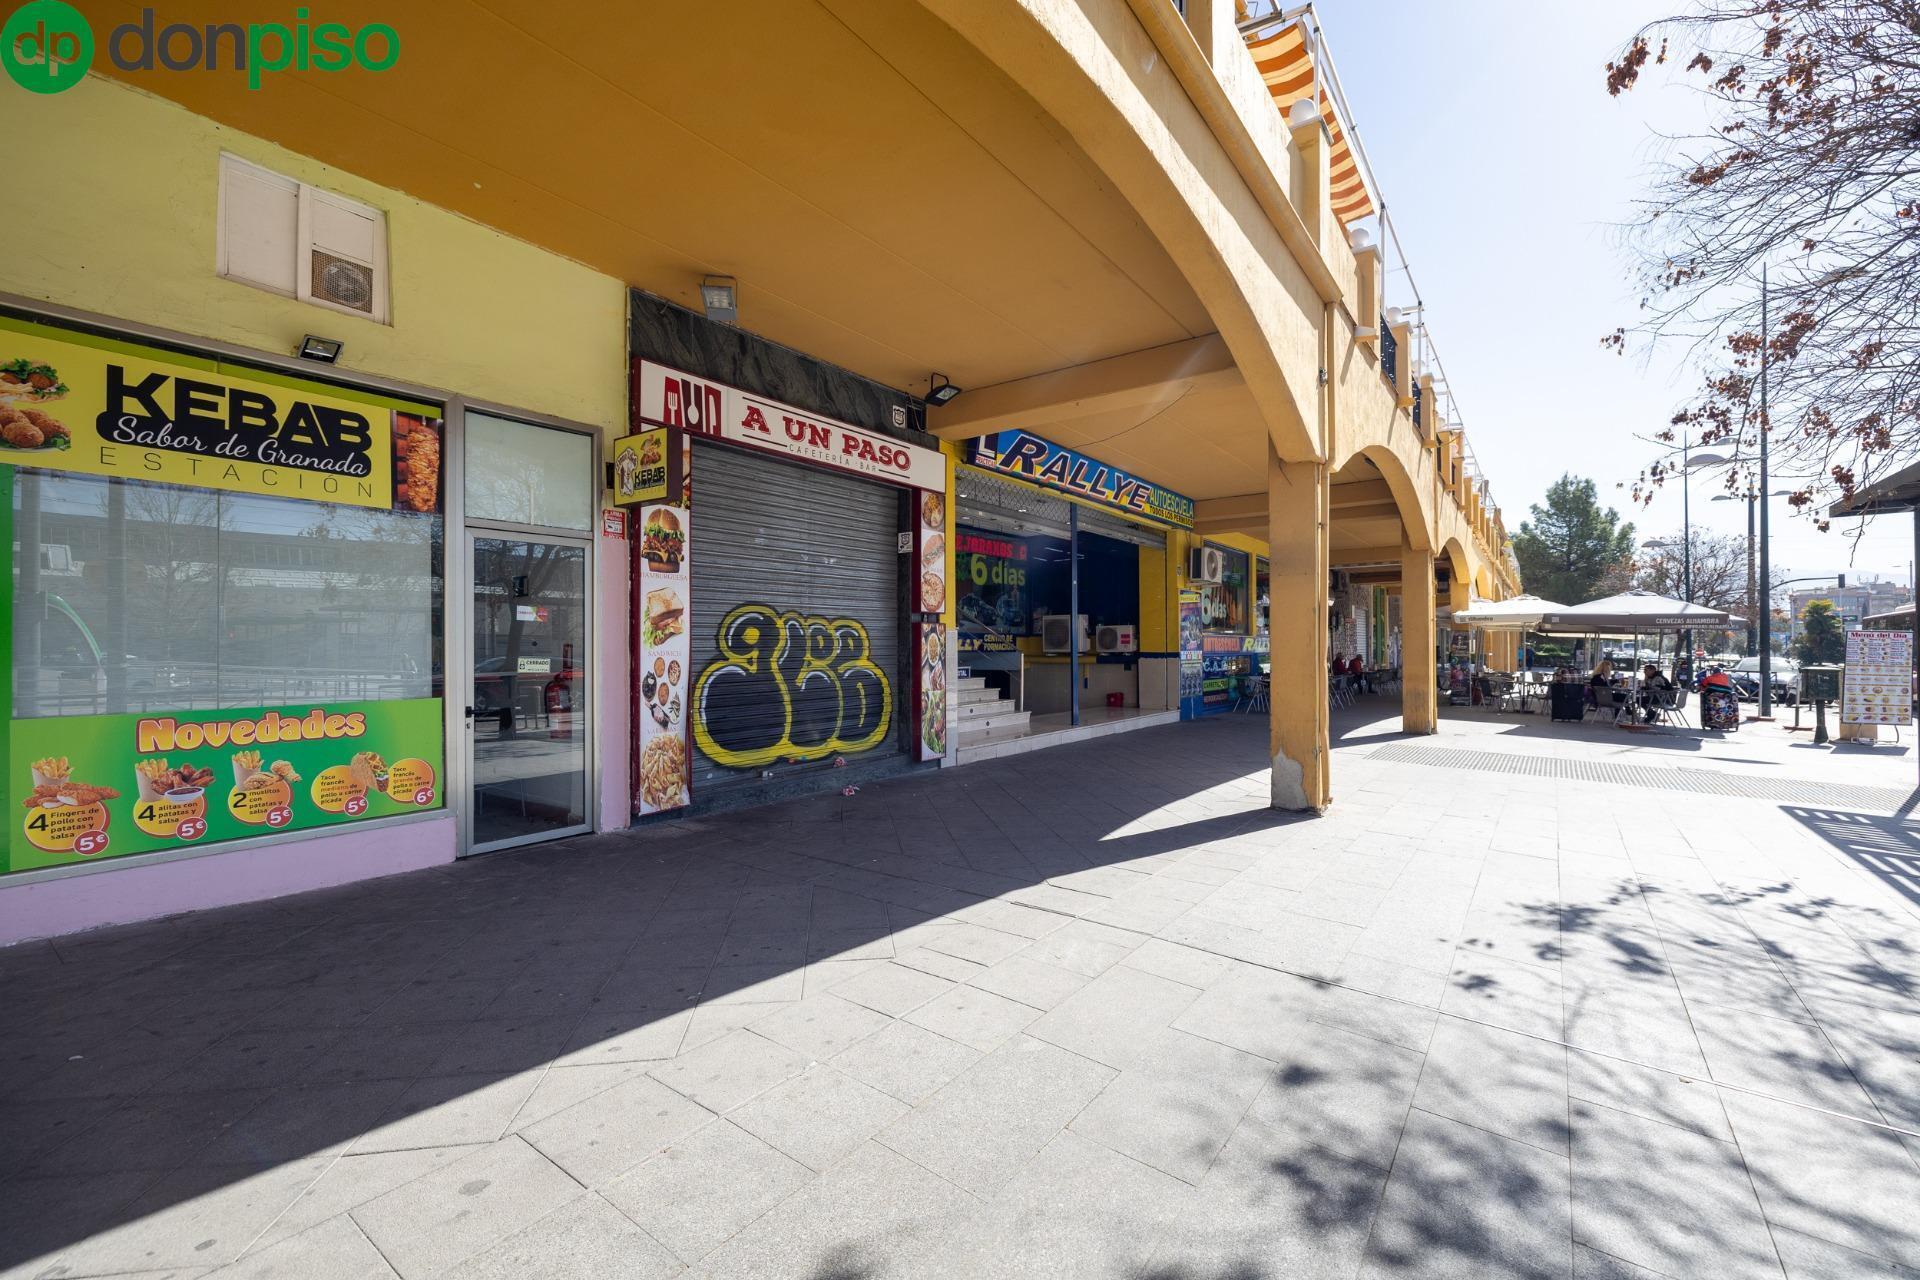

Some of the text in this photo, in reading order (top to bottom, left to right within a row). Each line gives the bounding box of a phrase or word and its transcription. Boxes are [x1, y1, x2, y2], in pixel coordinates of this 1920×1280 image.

[106, 364, 372, 452] KEBAB
[113, 415, 368, 476] Sabor de Granada
[741, 405, 912, 472] A UN PASO
[99, 446, 372, 498] ESTACIÓN
[634, 466, 665, 485] KEBAB
[997, 433, 1152, 511] RALLYE
[1149, 487, 1194, 519] AUTOESCUELA
[971, 553, 987, 586] 6
[137, 710, 366, 753] Novedades
[233, 792, 247, 808] 2
[249, 788, 280, 796] muslitos
[417, 790, 433, 802] 6€
[138, 805, 156, 821] 4
[158, 803, 181, 811] alitas
[348, 799, 366, 812] 5€
[28, 813, 49, 831] 4
[51, 809, 86, 819] Fingers
[158, 810, 189, 819] patatas
[270, 809, 291, 824] 5€
[51, 818, 75, 827] pollo
[51, 825, 86, 834] patatas
[181, 821, 204, 837] 5€
[51, 832, 75, 840] salsa
[79, 834, 106, 851] 5€
